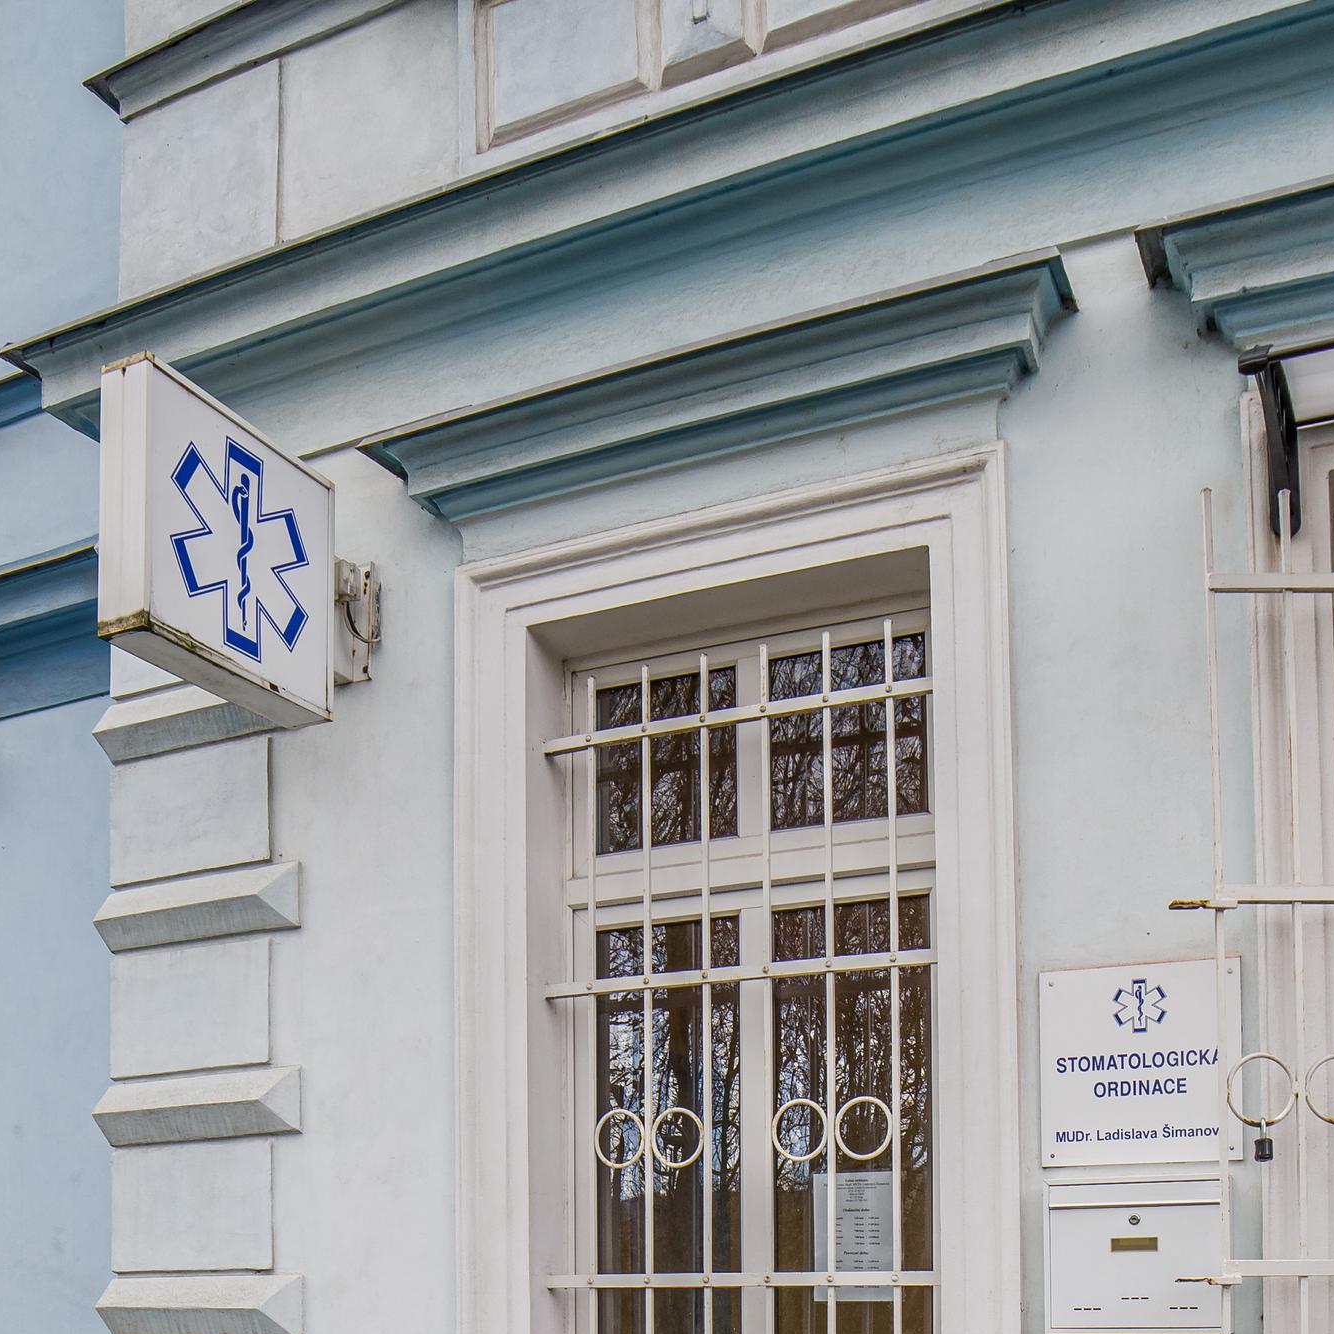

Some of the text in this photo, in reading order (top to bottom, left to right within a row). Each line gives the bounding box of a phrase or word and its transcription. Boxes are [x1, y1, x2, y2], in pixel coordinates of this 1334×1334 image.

[1093, 1077, 1188, 1098] ORDINACE
[1055, 1123, 1220, 1143] MUDr. Ladislava Šimanov
